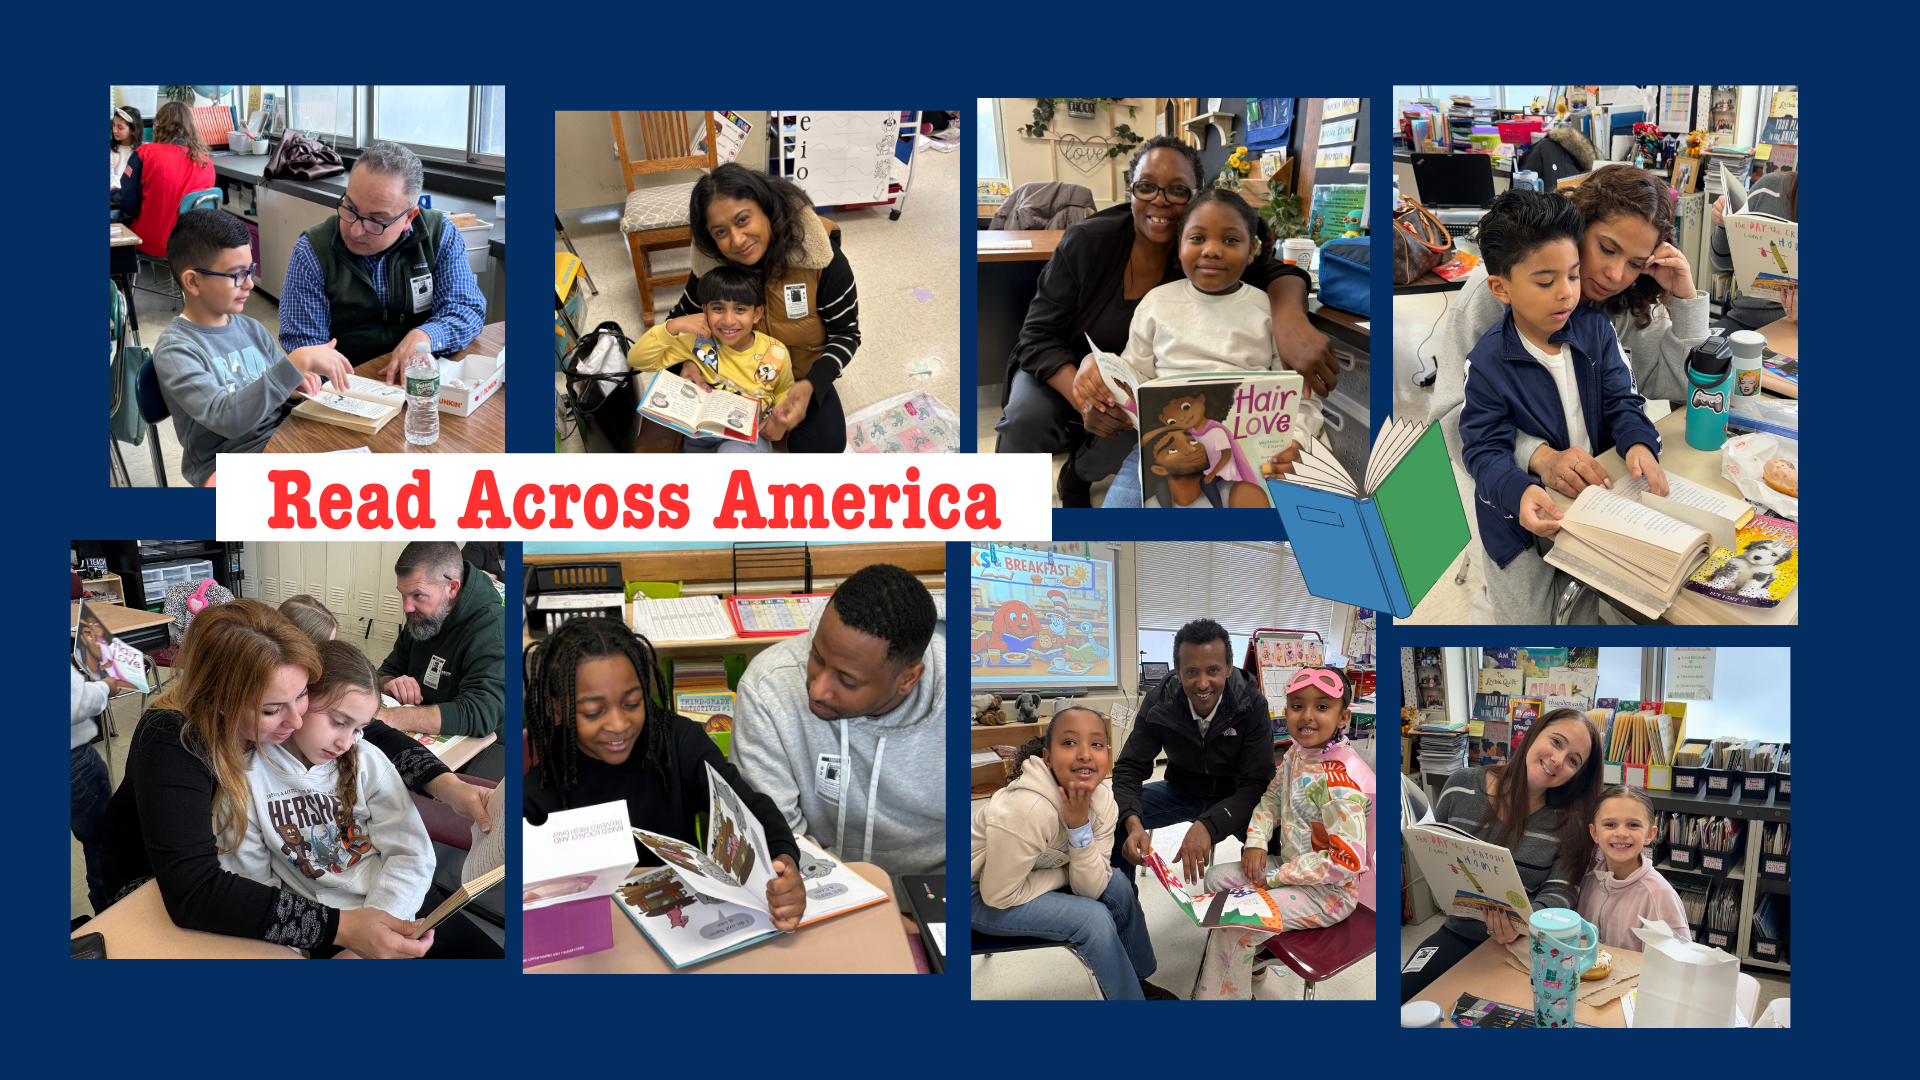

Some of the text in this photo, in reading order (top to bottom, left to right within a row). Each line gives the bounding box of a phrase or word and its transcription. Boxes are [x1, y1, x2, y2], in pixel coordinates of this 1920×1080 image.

[1068, 101, 1095, 114] CHOOSE
[800, 116, 811, 131] e
[1790, 120, 1798, 130] PLA
[800, 141, 806, 158] i
[1065, 138, 1104, 160] love
[796, 166, 808, 180] o
[1750, 221, 1767, 232] DAY
[1786, 230, 1798, 239] CR
[416, 382, 434, 390] Poland
[439, 398, 462, 408] UNKIN'
[1236, 384, 1297, 414] Hair
[1233, 412, 1290, 440] Love
[971, 550, 990, 568] KS
[1004, 556, 1070, 576] BREAKFAST
[1550, 656, 1561, 664] Day
[1529, 683, 1567, 697] ALMA
[1499, 695, 1508, 705] PLA
[268, 793, 341, 833] HERSHE
[553, 820, 622, 839] DELIVERED FRESH DAILY
[554, 825, 624, 844] BAKED LOCALLY AND
[1431, 835, 1448, 848] DAY
[1467, 846, 1504, 863] CRAYONS
[1463, 855, 1499, 875] HOME
